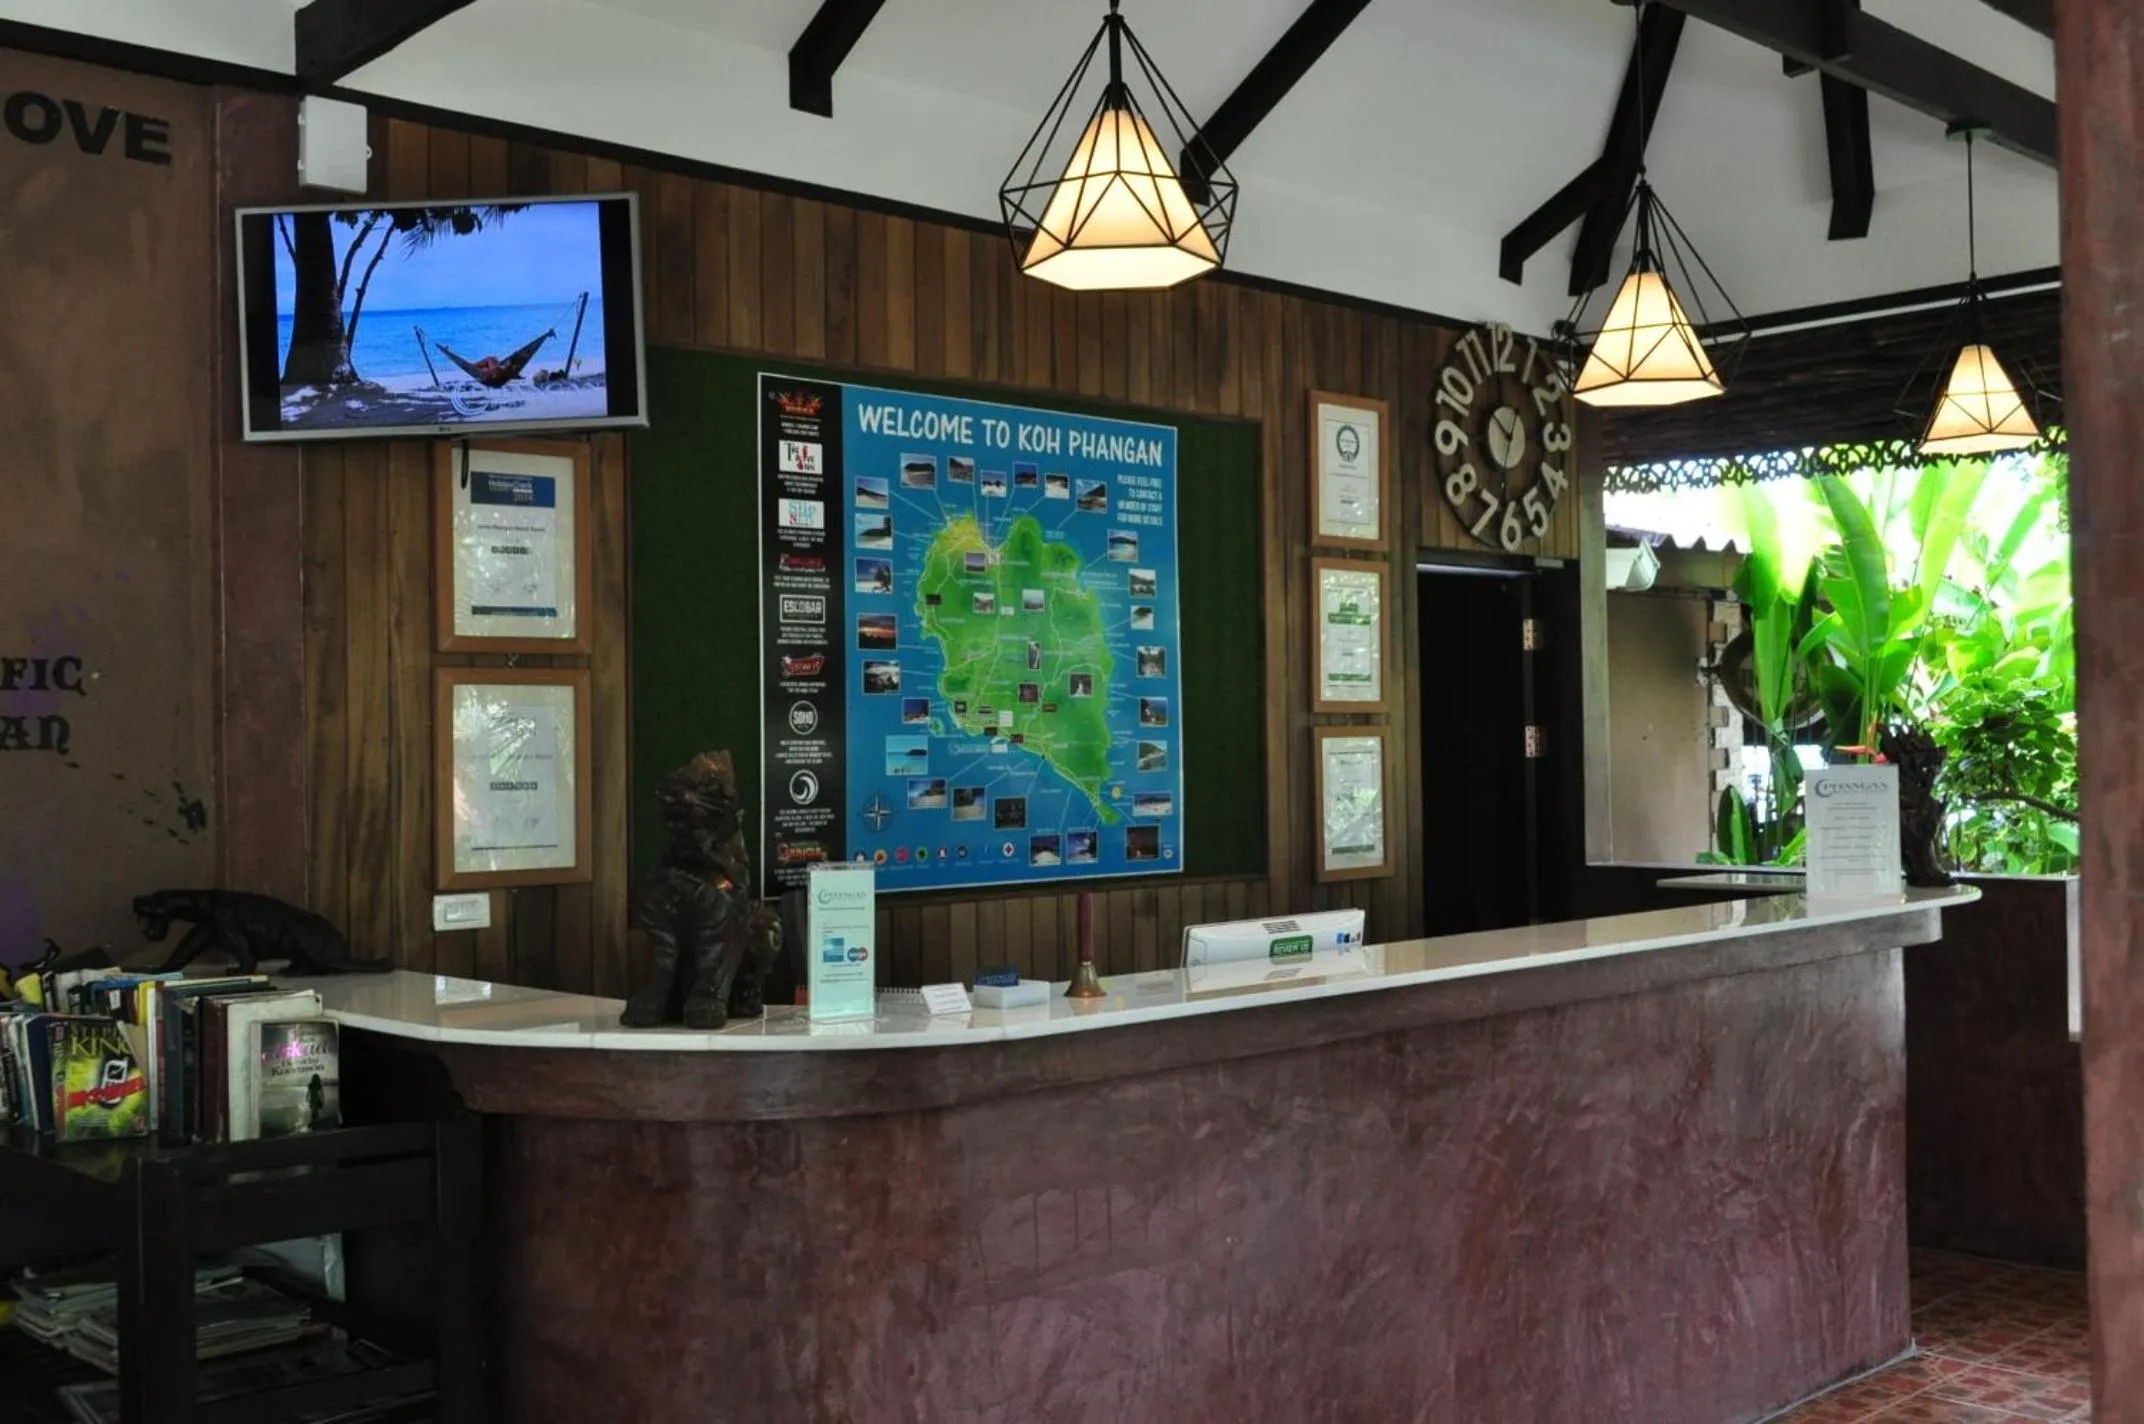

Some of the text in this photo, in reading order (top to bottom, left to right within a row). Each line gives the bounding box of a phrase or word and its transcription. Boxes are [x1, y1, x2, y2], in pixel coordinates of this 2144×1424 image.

[3, 91, 172, 165] OVE
[1456, 329, 1492, 385] 11
[1486, 320, 1516, 372] 12
[1521, 336, 1538, 384] 1
[1435, 365, 1474, 417] 10
[1533, 372, 1567, 417] 2
[858, 402, 973, 446] WELCOME
[981, 418, 1011, 450] TO
[1018, 423, 1061, 456] KOH
[1068, 427, 1163, 468] PHANGAN
[1435, 419, 1469, 456] 9
[1543, 422, 1572, 453] 3
[1445, 463, 1477, 505] 8
[1541, 461, 1569, 500] 4
[1470, 488, 1499, 536] 7
[1500, 500, 1522, 552] 6
[1522, 486, 1549, 538] 5
[784, 599, 822, 614] ESCOBAR
